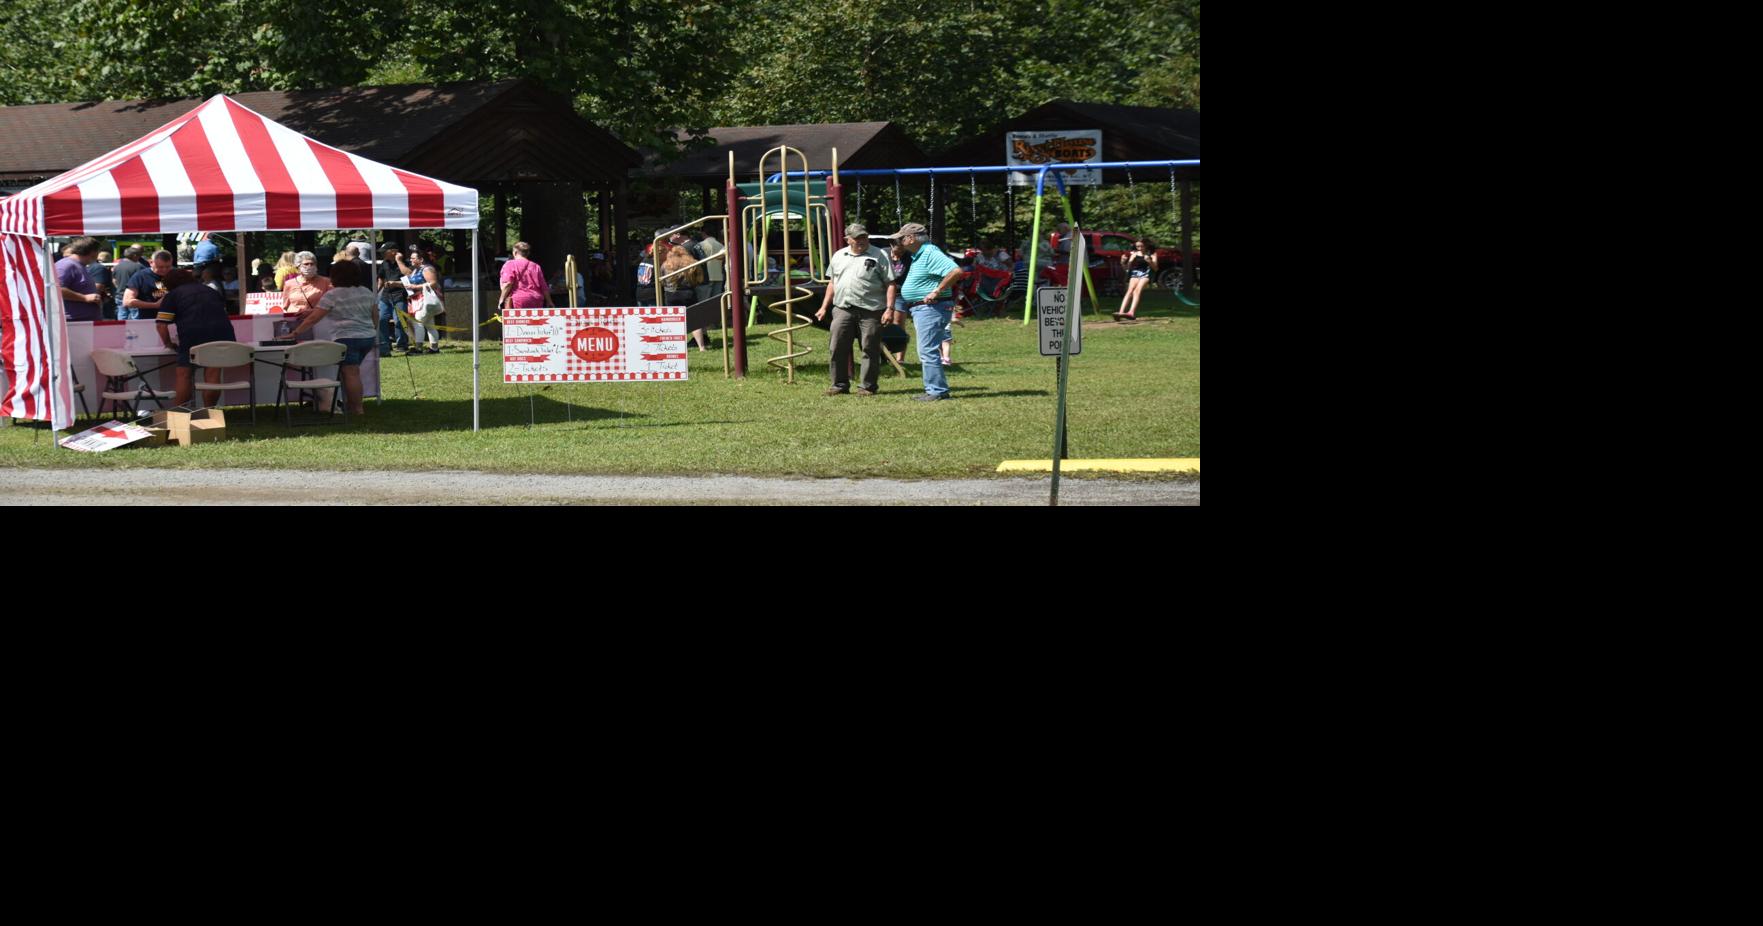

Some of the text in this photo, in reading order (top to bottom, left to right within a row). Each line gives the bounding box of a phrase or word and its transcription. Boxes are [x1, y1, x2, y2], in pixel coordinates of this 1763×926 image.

[1054, 293, 1065, 303] NO
[1041, 306, 1065, 315] VEHIC
[1044, 317, 1065, 326] BEYO
[1052, 329, 1064, 338] THI
[577, 337, 613, 352] MENU
[1049, 340, 1062, 350] POI
